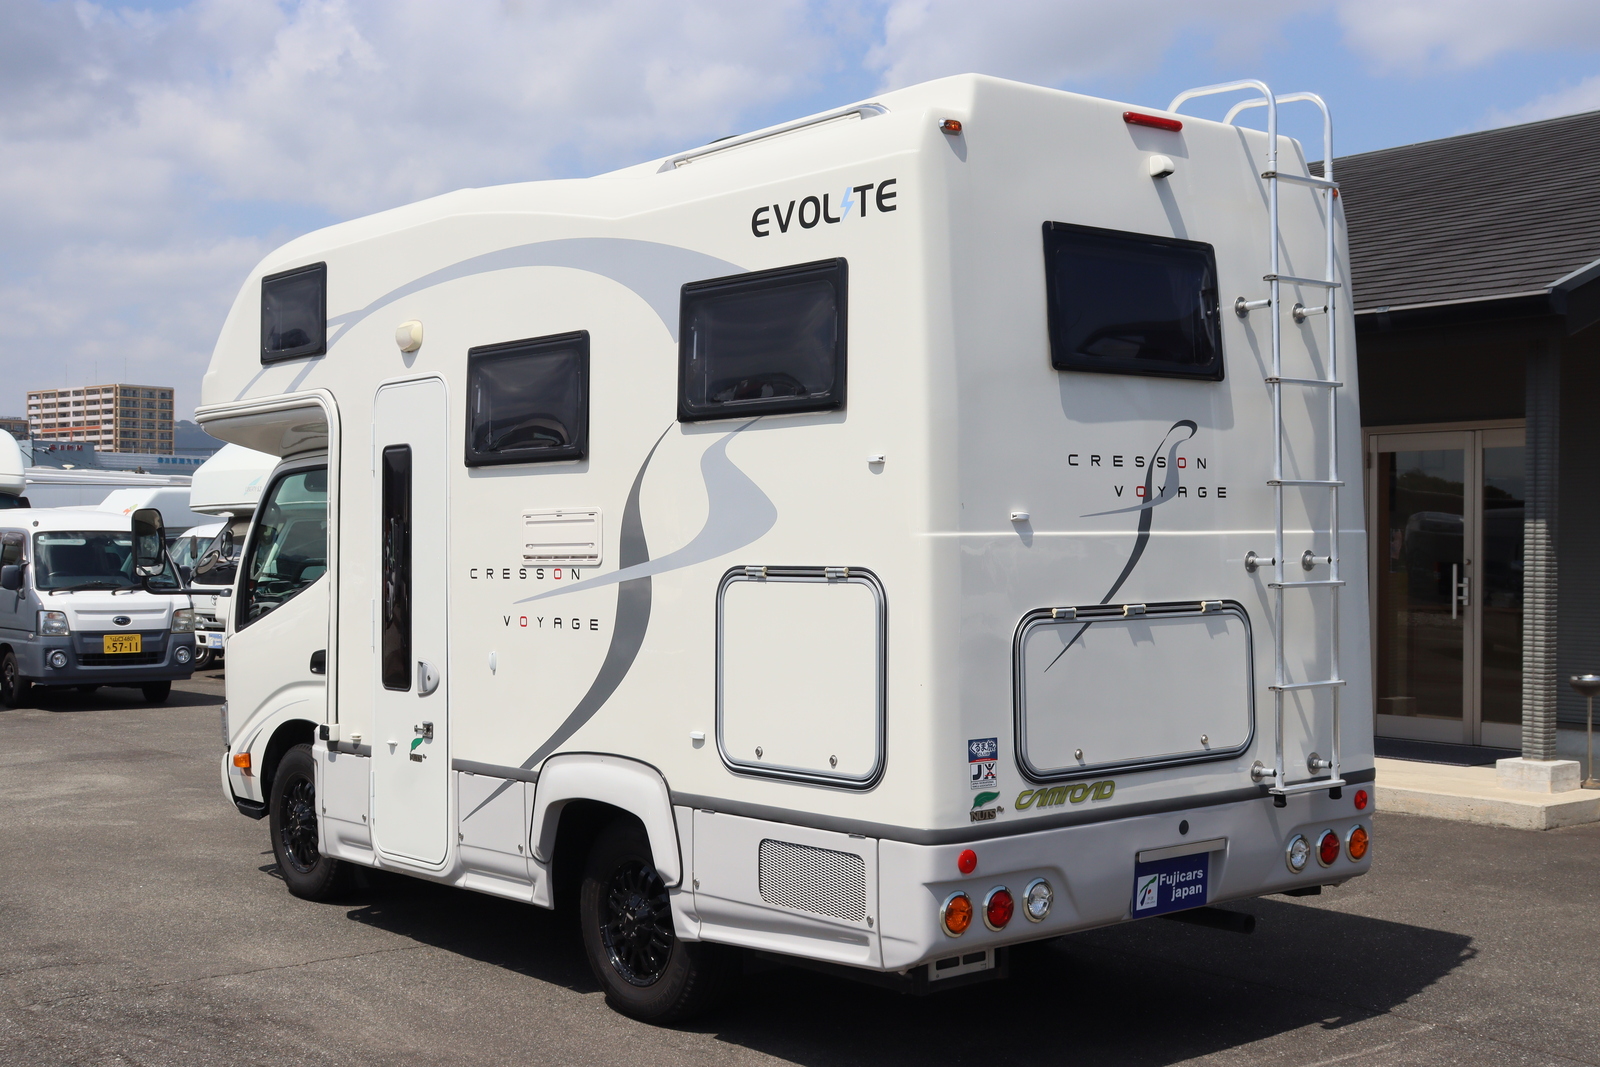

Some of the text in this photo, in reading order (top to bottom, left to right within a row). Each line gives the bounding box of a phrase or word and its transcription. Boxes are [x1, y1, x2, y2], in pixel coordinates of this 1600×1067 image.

[1068, 454, 1207, 469] CRESSON
[1114, 485, 1227, 498] VOYAGE
[470, 568, 580, 580] CRESSON
[503, 615, 599, 630] VOYAGE
[112, 642, 138, 652] 57-11
[1014, 780, 1115, 810] CAMROAD
[969, 809, 997, 822] NUTS
[1159, 869, 1204, 887] Fujicars
[1171, 884, 1203, 902] japan
